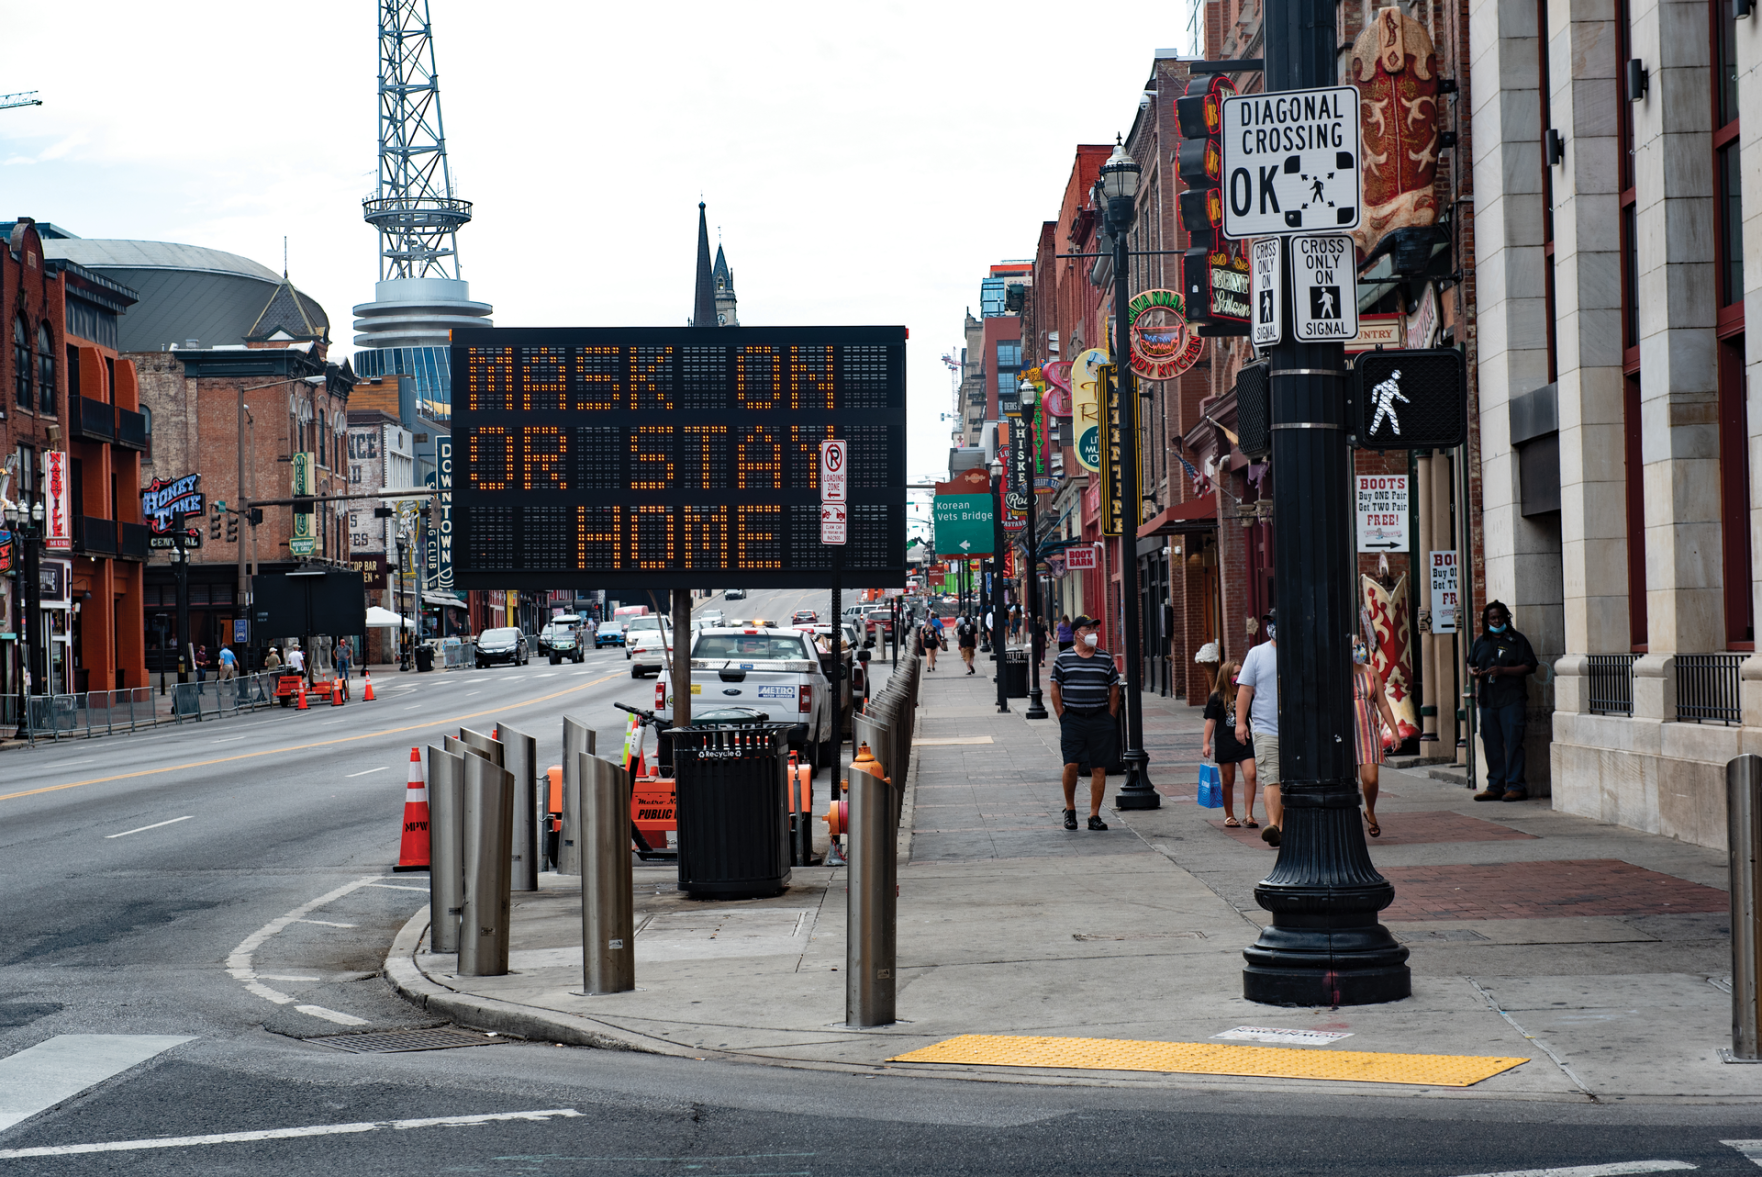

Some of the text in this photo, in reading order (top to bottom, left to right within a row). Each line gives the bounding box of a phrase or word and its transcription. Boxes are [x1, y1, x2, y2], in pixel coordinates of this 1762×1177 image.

[1240, 94, 1343, 127] DIAGONAL
[1242, 122, 1342, 155] CROSSING
[1230, 165, 1281, 217] OK
[1255, 242, 1277, 259] CROSS
[1301, 238, 1345, 254] CROSS
[1257, 257, 1275, 275] ONLY
[1305, 254, 1341, 270] ONLY
[1212, 268, 1249, 294] BENT
[1261, 275, 1271, 289] ON
[1315, 270, 1333, 285] ON
[1256, 324, 1277, 340] SIGNAL
[1305, 321, 1348, 336] SIGNAL
[1157, 335, 1202, 377] KITCHEN
[469, 345, 834, 410] MASK ON
[1013, 417, 1026, 482] WHISKE
[469, 425, 835, 490] OR STAY
[823, 474, 844, 482] LOADING
[1360, 478, 1405, 490] BOOTS
[49, 452, 64, 537] NASHVILLE
[143, 474, 197, 515] HONKY
[827, 483, 840, 491] ZONE
[441, 443, 452, 563] DOWNTOWN
[1359, 491, 1407, 501] Buy ONE Pair
[154, 494, 201, 531] TONK
[936, 501, 970, 511] Korean
[1359, 503, 1407, 512] Get TWO Pair
[937, 511, 993, 522] Vets Bridge
[1367, 514, 1399, 526] FREE!
[150, 537, 198, 547] CENTAL
[577, 505, 781, 569] HOME
[427, 541, 437, 569] CLUB
[1069, 550, 1093, 559] BOOT
[364, 561, 377, 571] BAR
[1069, 558, 1093, 567] BARN
[1433, 568, 1447, 579] Buy
[1433, 580, 1446, 589] Get
[759, 686, 794, 694] METRO
[705, 750, 735, 758] Recycle
[637, 808, 673, 820] PUBLIC
[405, 821, 428, 832] MPW
